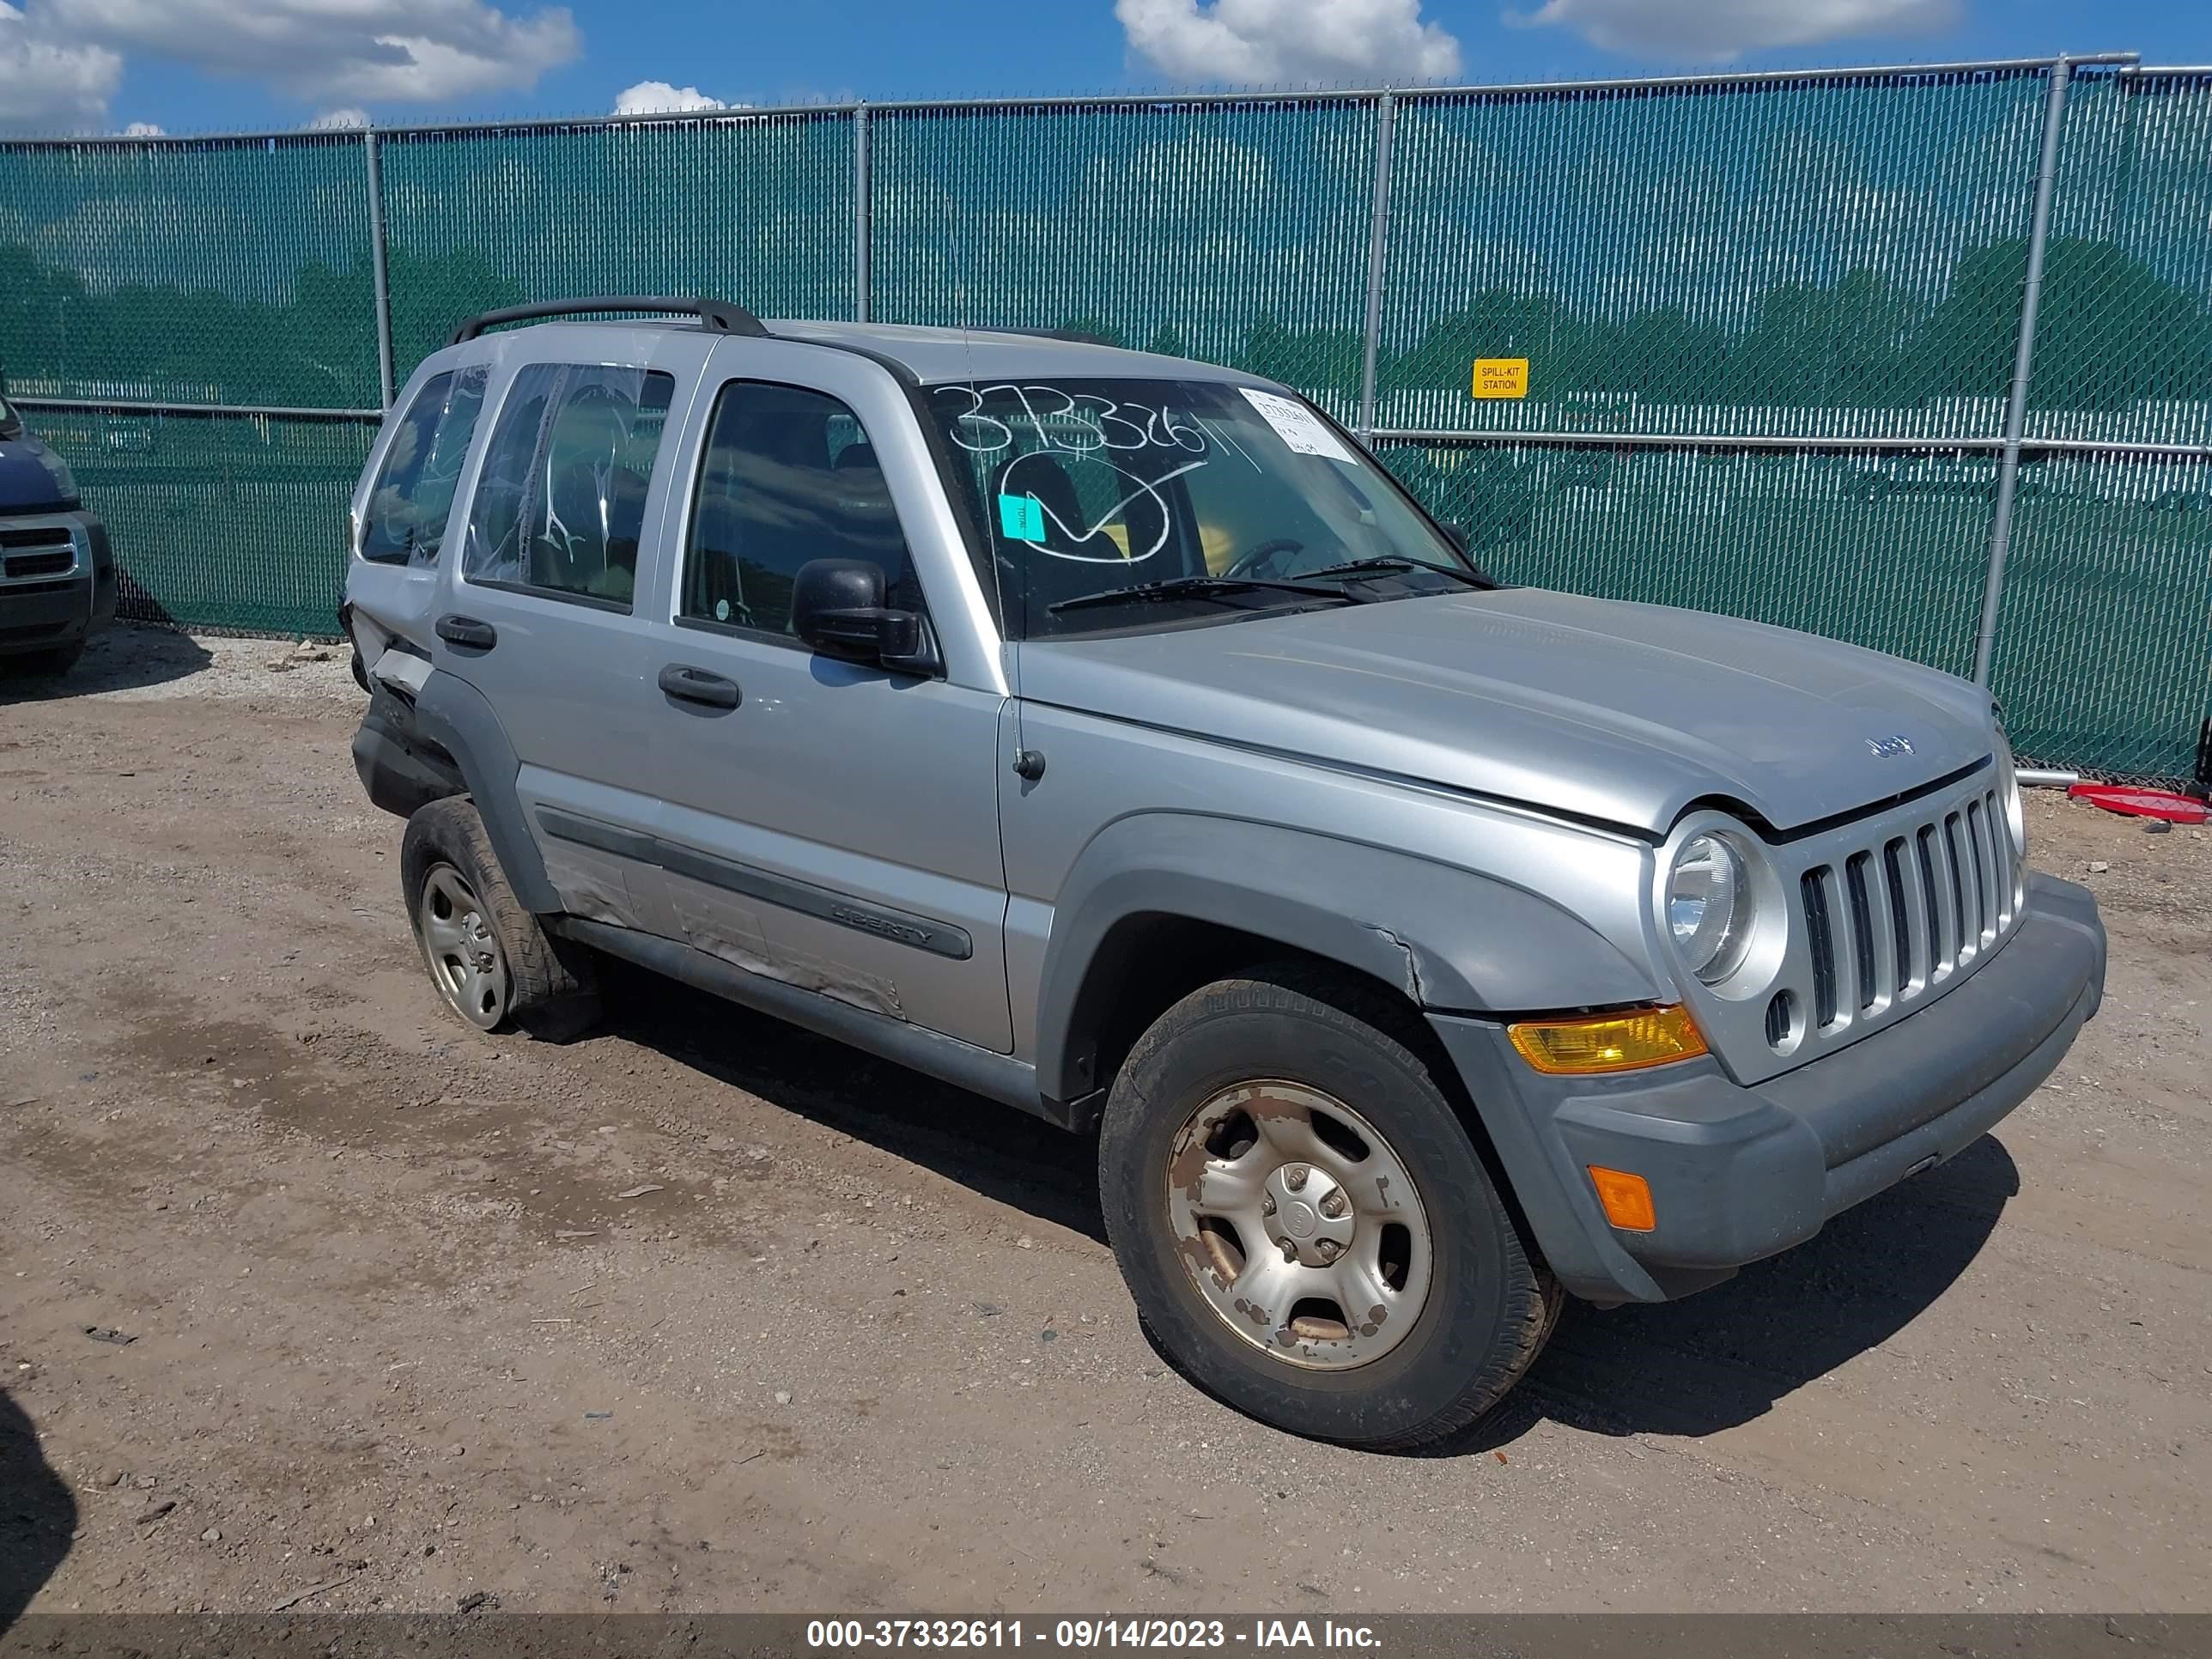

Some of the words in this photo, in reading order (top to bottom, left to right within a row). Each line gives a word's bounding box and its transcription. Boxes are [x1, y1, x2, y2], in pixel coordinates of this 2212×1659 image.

[1481, 367, 1520, 377] SPILL-KIT
[1483, 380, 1516, 390] STATION
[830, 904, 933, 944] LIBERTY
